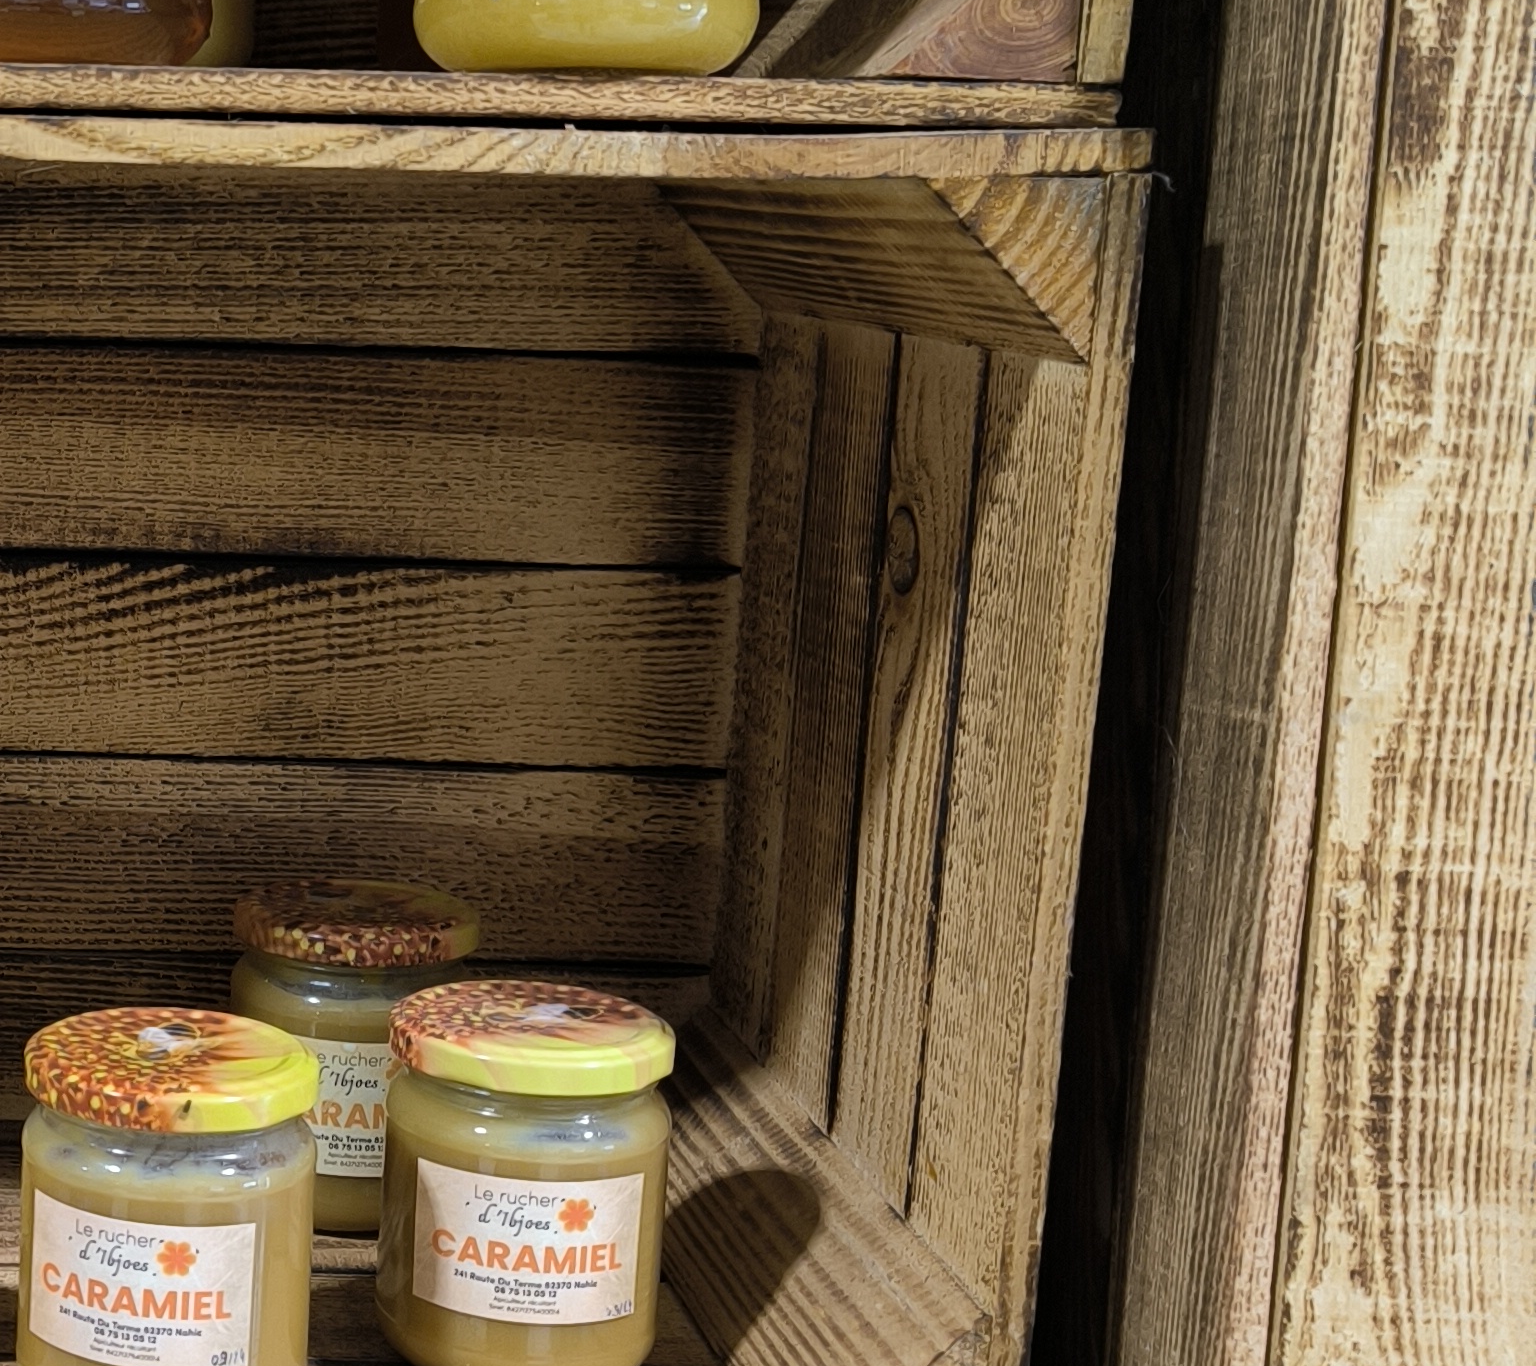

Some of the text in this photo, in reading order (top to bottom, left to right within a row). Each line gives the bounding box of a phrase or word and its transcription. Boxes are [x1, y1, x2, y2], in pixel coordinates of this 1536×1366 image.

[332, 1052, 385, 1067] rucher
[332, 1134, 343, 1142] Du
[474, 1184, 558, 1208] Le rucher
[75, 1218, 157, 1248] Le rucher
[431, 1229, 622, 1275] CARAMIEL
[454, 1268, 468, 1279] 241
[469, 1271, 496, 1284] Route
[497, 1277, 511, 1286] Du
[42, 1262, 232, 1320] CARAMIEL
[508, 1287, 520, 1295] 75
[522, 1289, 531, 1297] 13
[97, 1317, 110, 1328] Du
